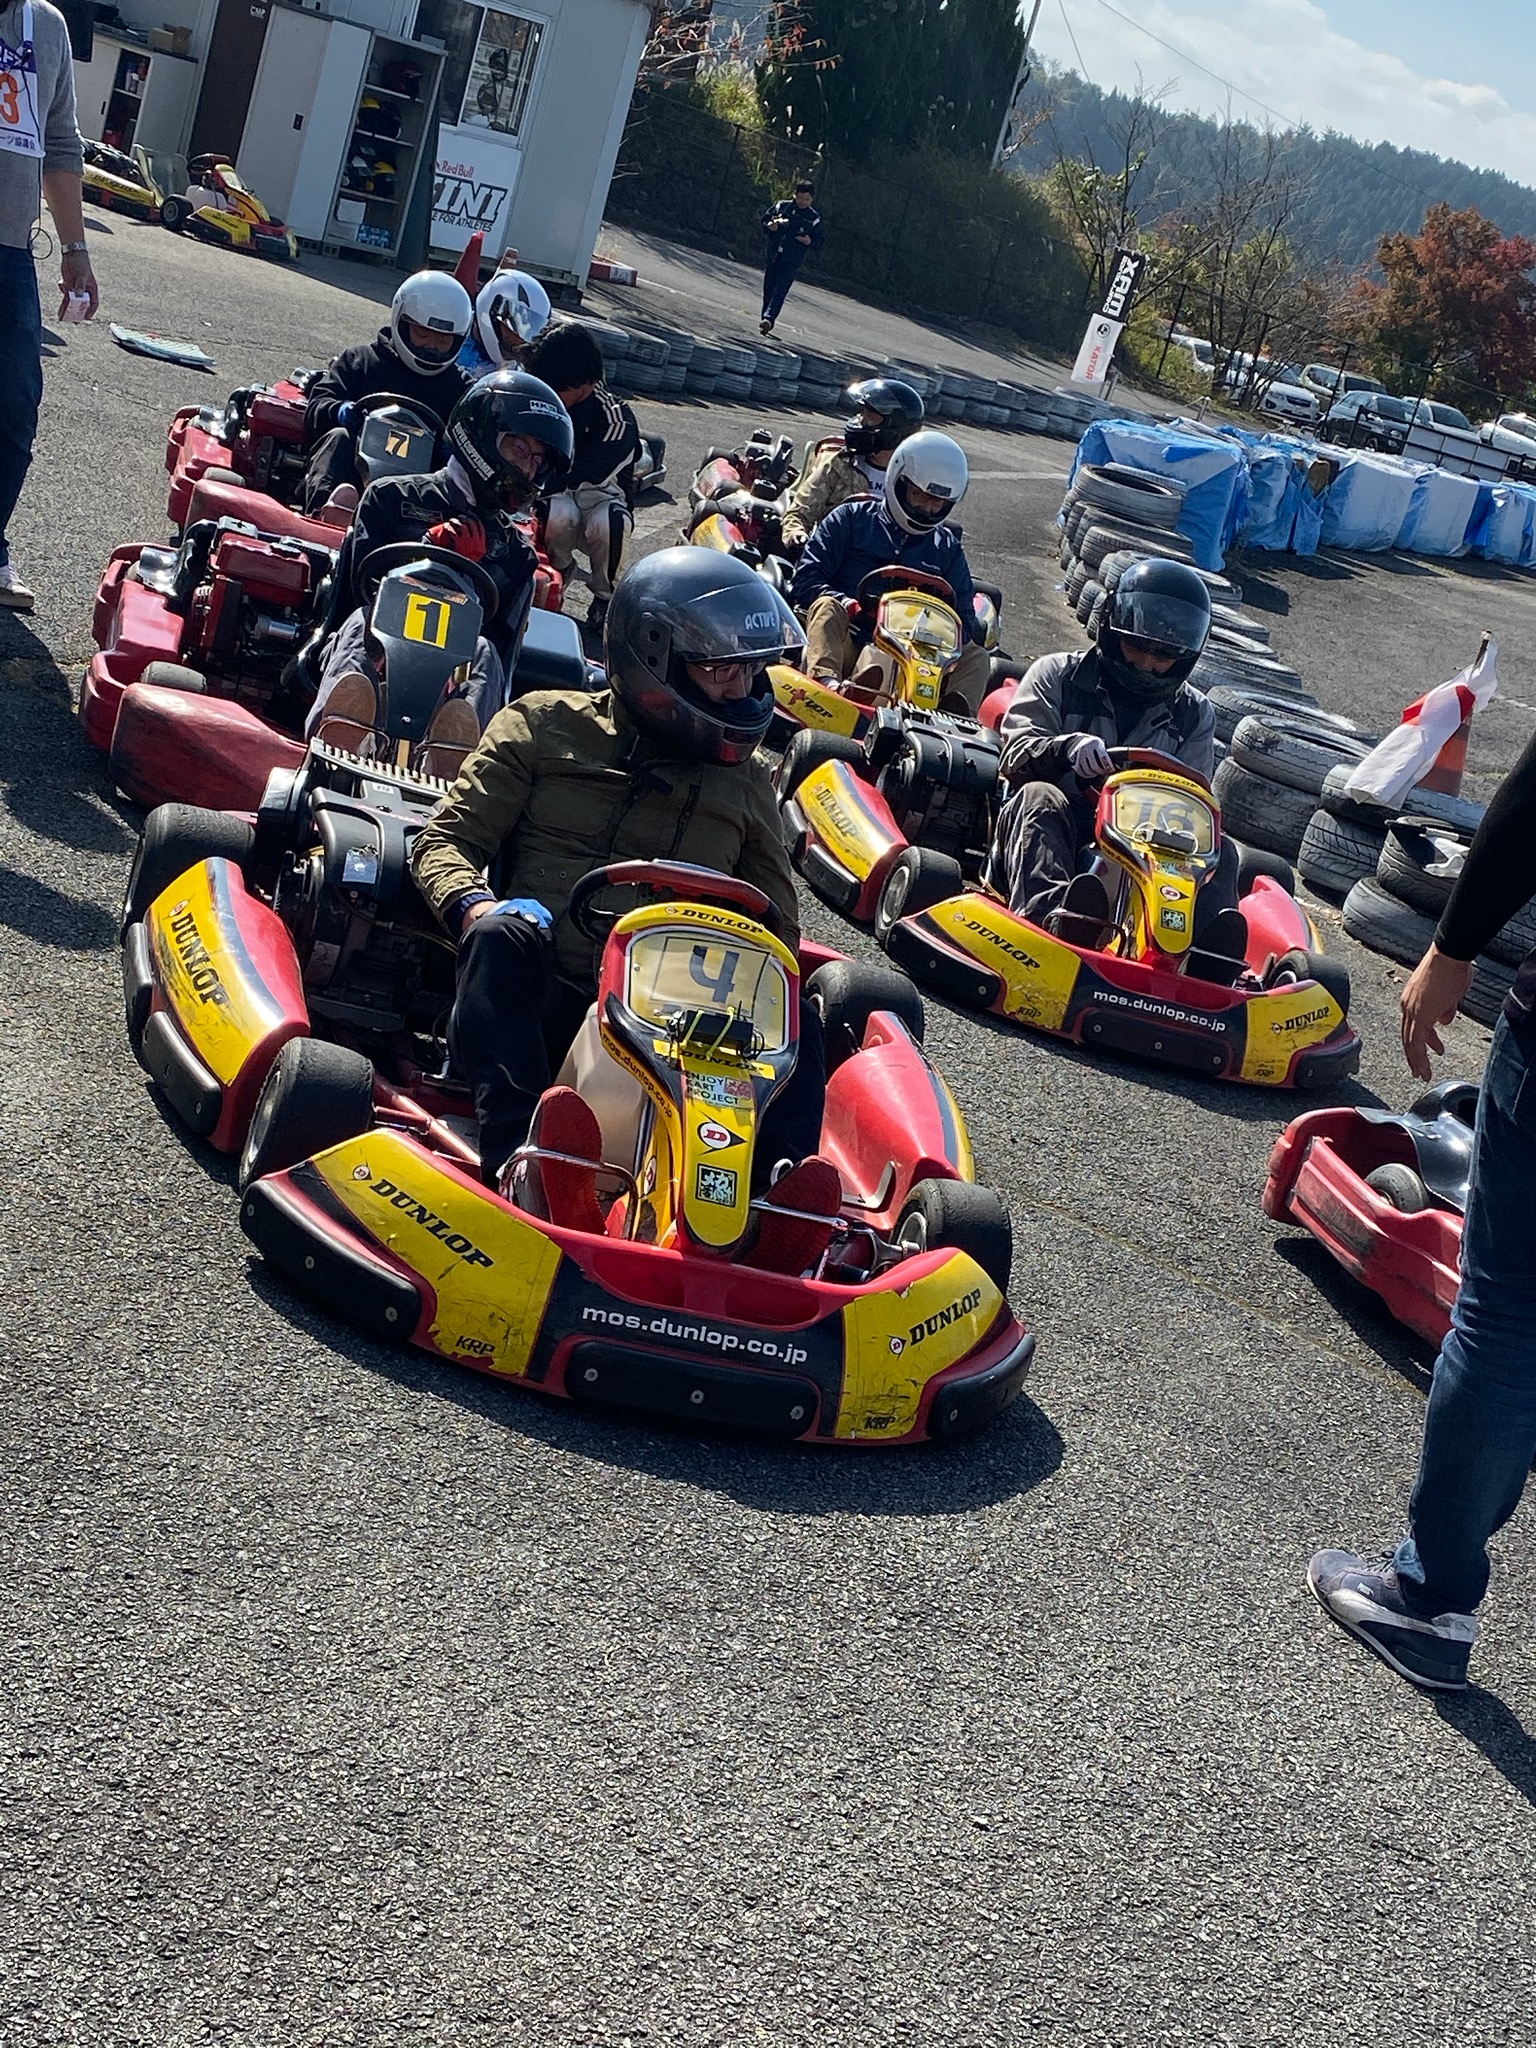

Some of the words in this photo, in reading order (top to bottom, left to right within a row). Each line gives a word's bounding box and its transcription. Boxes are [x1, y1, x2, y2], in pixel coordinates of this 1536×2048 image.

[441, 160, 458, 174] Red
[458, 163, 474, 178] Bull
[432, 172, 508, 224] INI
[439, 213, 455, 224] FOR
[456, 217, 493, 233] ATHLETES
[390, 430, 409, 456] 7
[416, 600, 442, 643] 1
[745, 611, 776, 630] ACTIVE
[681, 909, 764, 934] DUNLOP
[171, 912, 230, 1005] DUNLOP
[965, 920, 1041, 969] DUNLOP
[690, 945, 740, 1003] 4
[1093, 990, 1226, 1032] mos.dunlop.co.jp
[1284, 1006, 1330, 1031] DUNLOP
[603, 1033, 673, 1118] mos.dunlop.co.jp
[685, 1071, 724, 1086] ENJOY
[686, 1088, 739, 1105] PROJECT
[369, 1178, 495, 1268] DUNLOP
[581, 1306, 808, 1365] mos.dunlop.co.jp
[908, 1288, 981, 1346] DUNLOP
[455, 1335, 496, 1355] KRP
